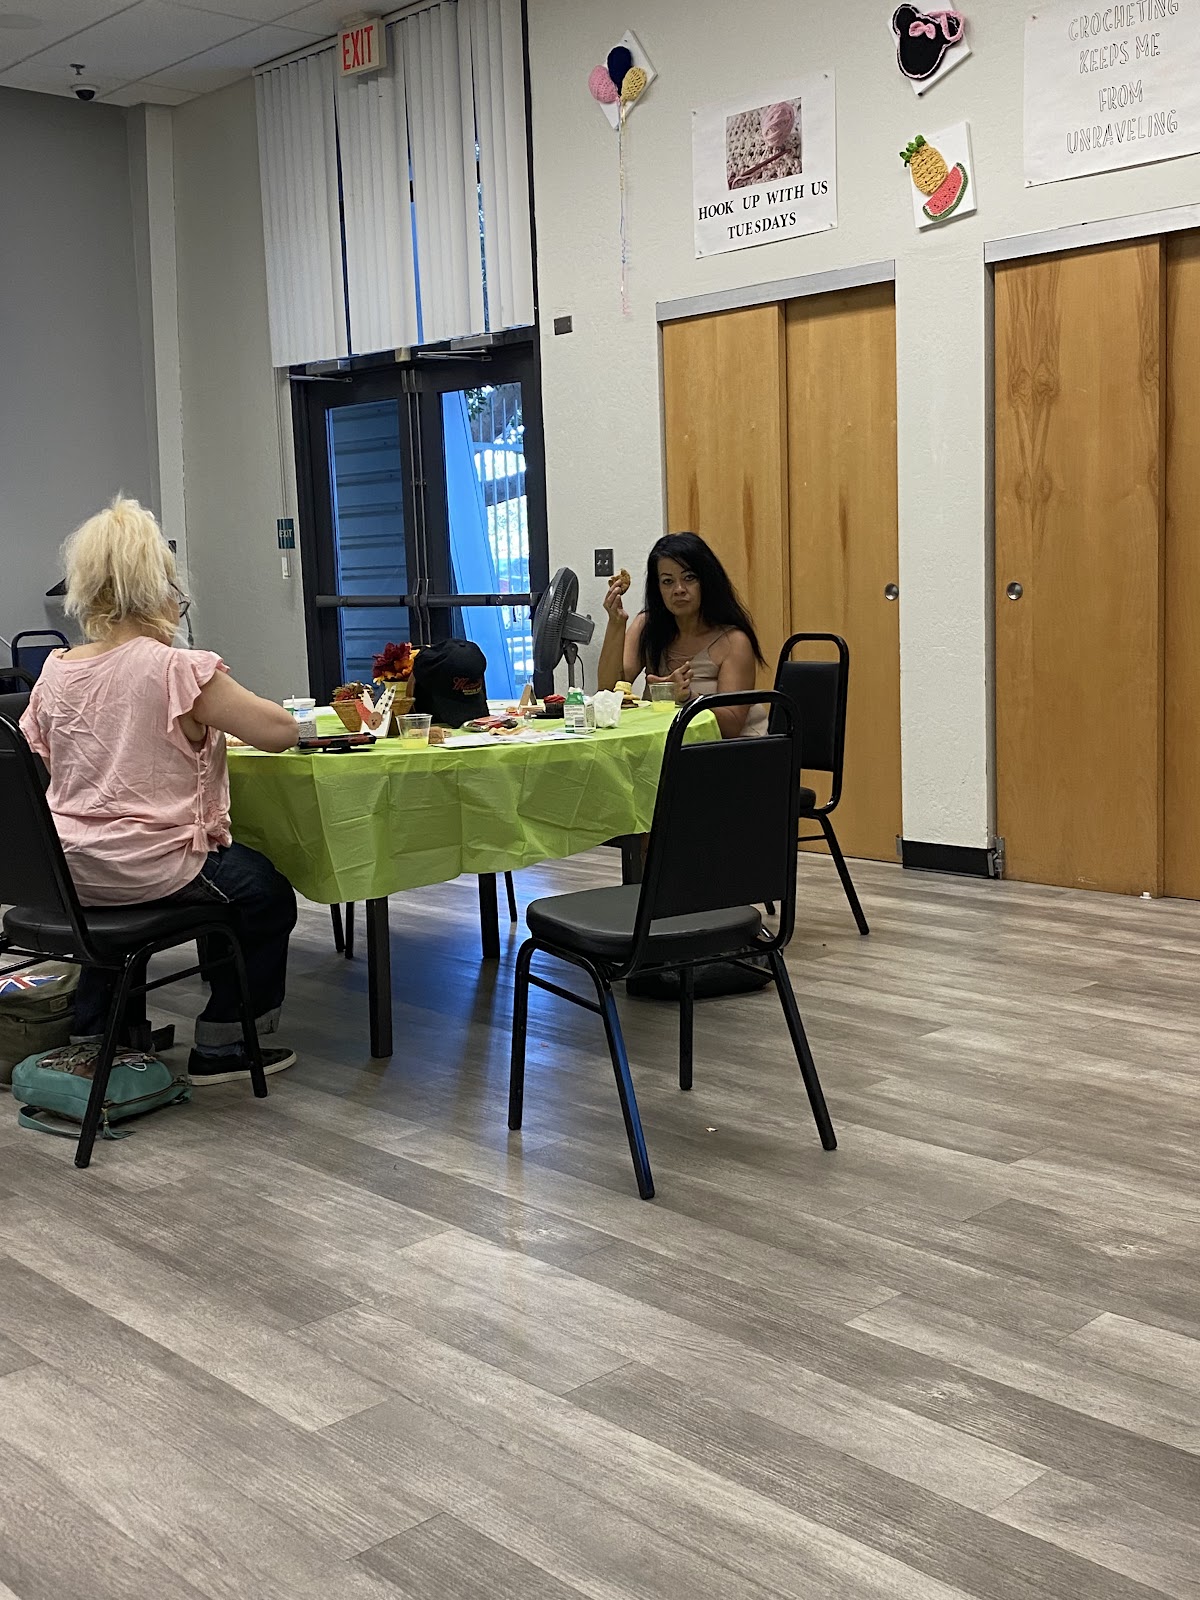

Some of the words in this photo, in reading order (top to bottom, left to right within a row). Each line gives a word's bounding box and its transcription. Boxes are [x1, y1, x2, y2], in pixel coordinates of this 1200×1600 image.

[1068, 0, 1179, 41] CROCHETING
[342, 25, 373, 71] EXIT
[1079, 41, 1130, 74] KEEPS
[1135, 32, 1161, 59] ME
[1098, 79, 1144, 112] FROM
[1066, 109, 1179, 154] UNRAVELING
[698, 200, 734, 220] HOOK
[742, 194, 760, 210] UP
[766, 184, 805, 205] WITH
[811, 180, 828, 196] US
[727, 211, 797, 239] TUESDAYS
[279, 529, 293, 538] EXIT
